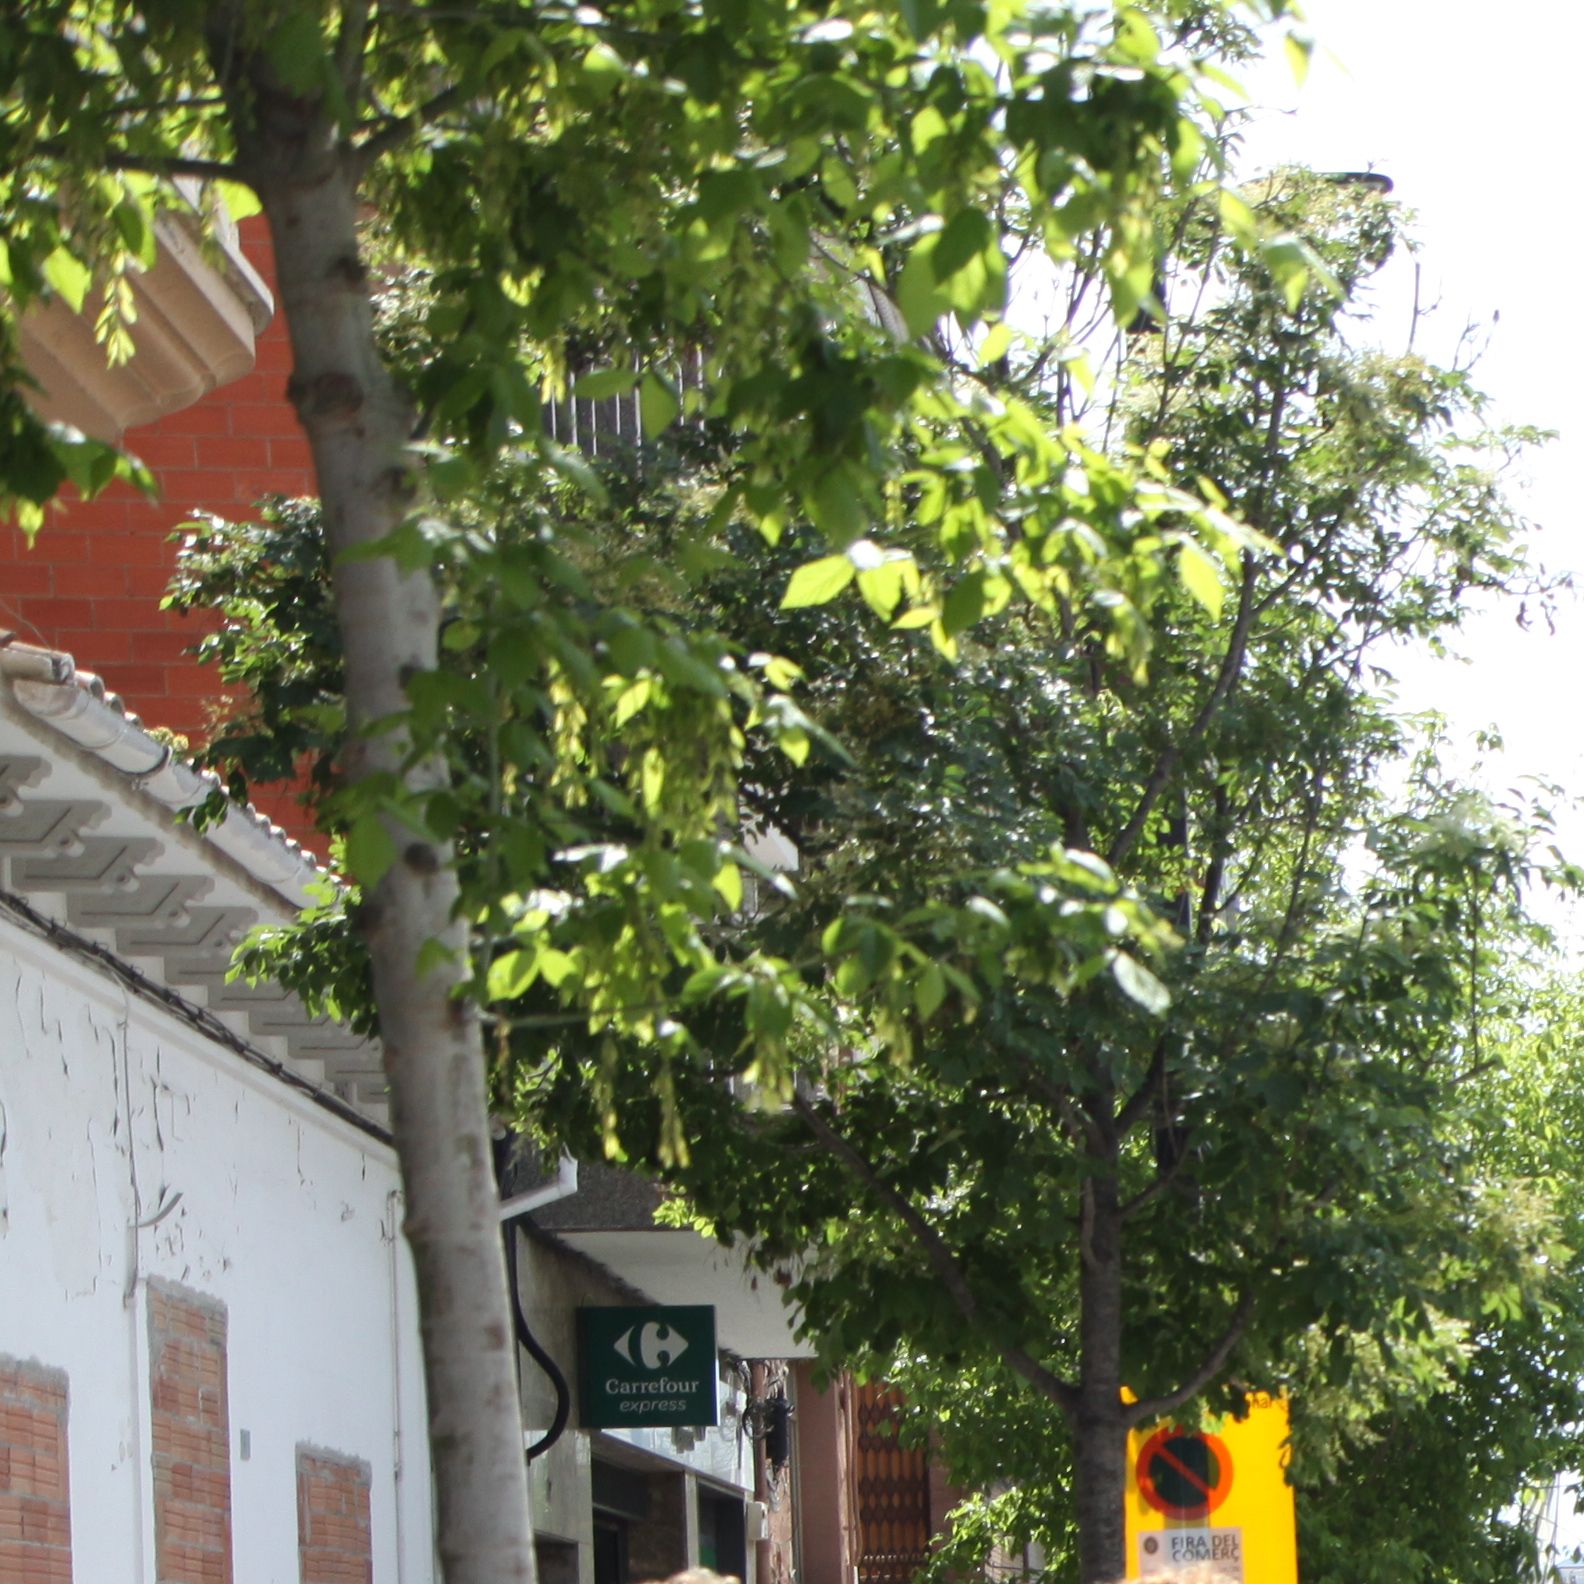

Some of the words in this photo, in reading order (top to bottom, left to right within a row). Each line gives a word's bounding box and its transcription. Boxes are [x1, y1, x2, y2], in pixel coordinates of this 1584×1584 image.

[605, 1377, 700, 1395] Carrefour
[619, 1400, 687, 1415] express
[1171, 1536, 1208, 1549] FIRA
[1212, 1535, 1239, 1547] DEL
[1172, 1546, 1239, 1562] COMERÇ
